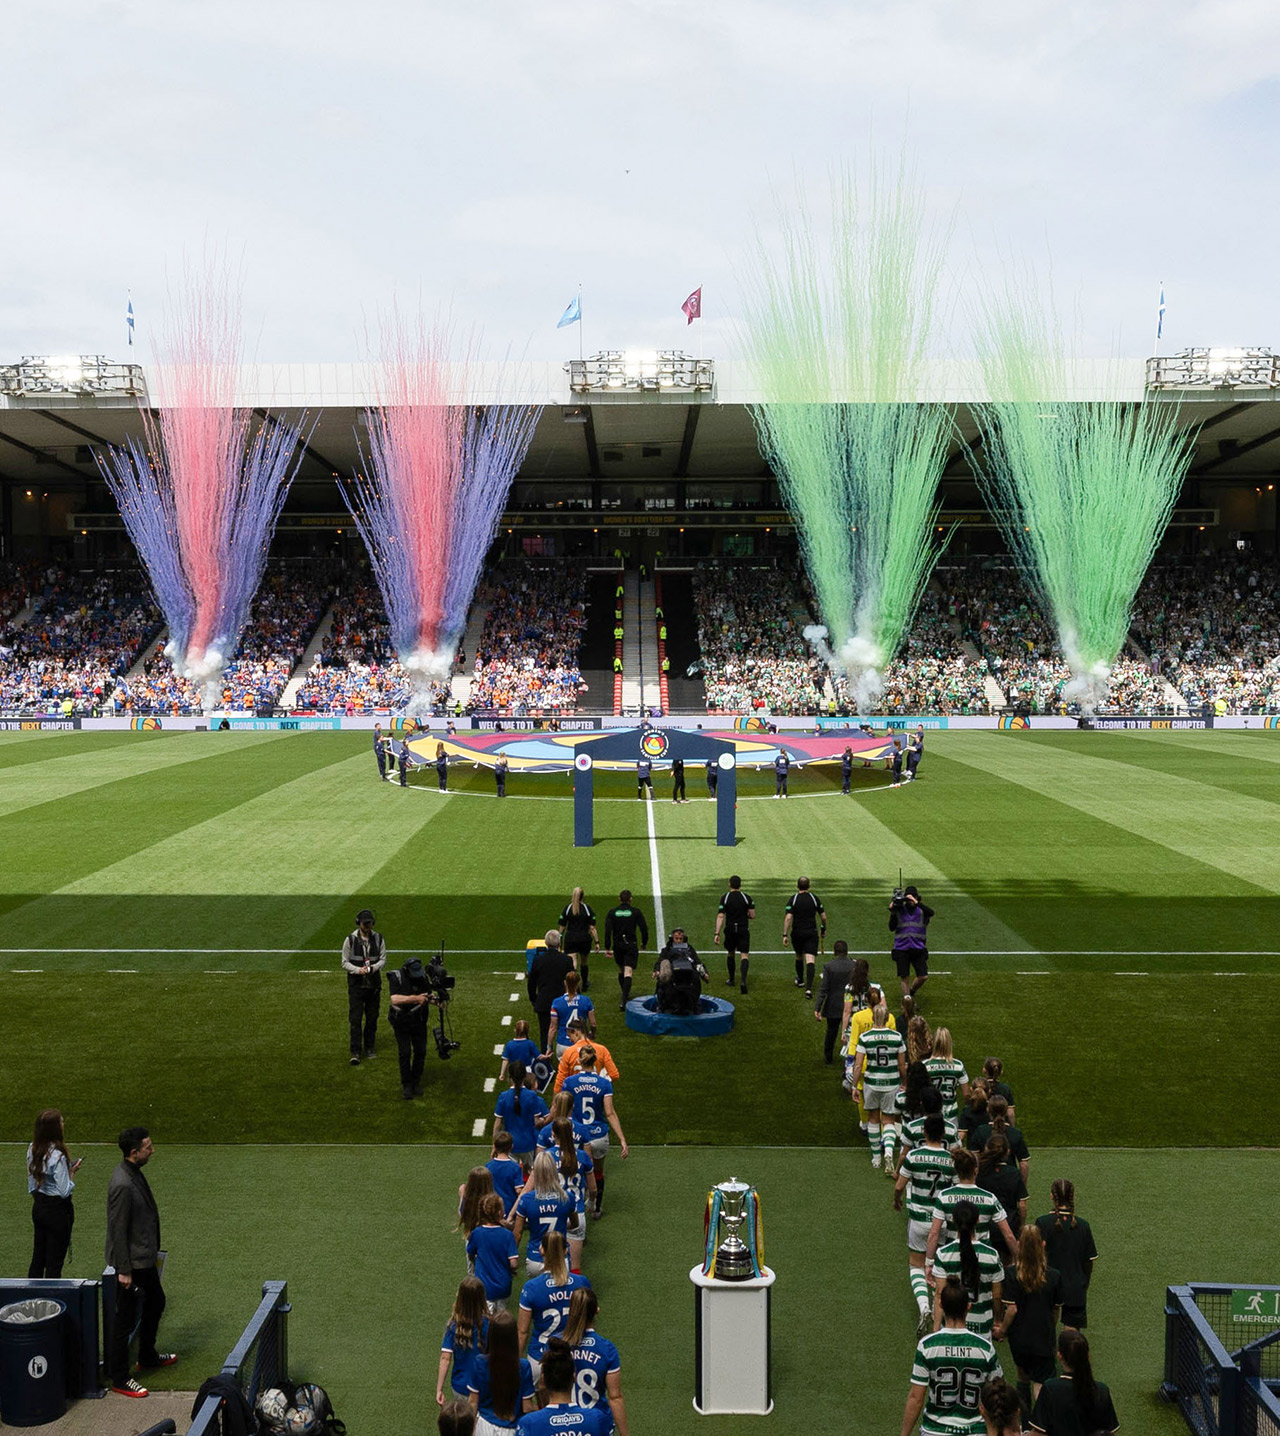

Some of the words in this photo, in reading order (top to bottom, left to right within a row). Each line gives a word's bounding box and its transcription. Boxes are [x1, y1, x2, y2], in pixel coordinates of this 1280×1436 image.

[7, 721, 20, 730] THE
[21, 721, 40, 730] NEXT
[41, 721, 74, 730] CHAPTER
[256, 721, 266, 730] TO
[266, 721, 280, 730] THE
[280, 721, 299, 730] NEXT
[300, 721, 333, 730] CHAPTER
[517, 721, 526, 729] TO
[561, 721, 594, 730] CHAPTER
[887, 721, 905, 729] NEXT
[1126, 720, 1136, 729] TO
[1137, 720, 1150, 729] THE
[1151, 720, 1171, 729] NEXT
[1171, 720, 1206, 729] CHAPTER
[876, 1044, 889, 1067] 6
[573, 1085, 602, 1095] DAVISON
[931, 1075, 957, 1101] 73
[581, 1096, 596, 1125] 5
[914, 1155, 953, 1166] GALLACHER
[926, 1169, 942, 1198] 7
[539, 1204, 558, 1214] HAY
[538, 1216, 559, 1235] 7
[945, 1346, 972, 1358] FLINT
[934, 1366, 982, 1410] 26
